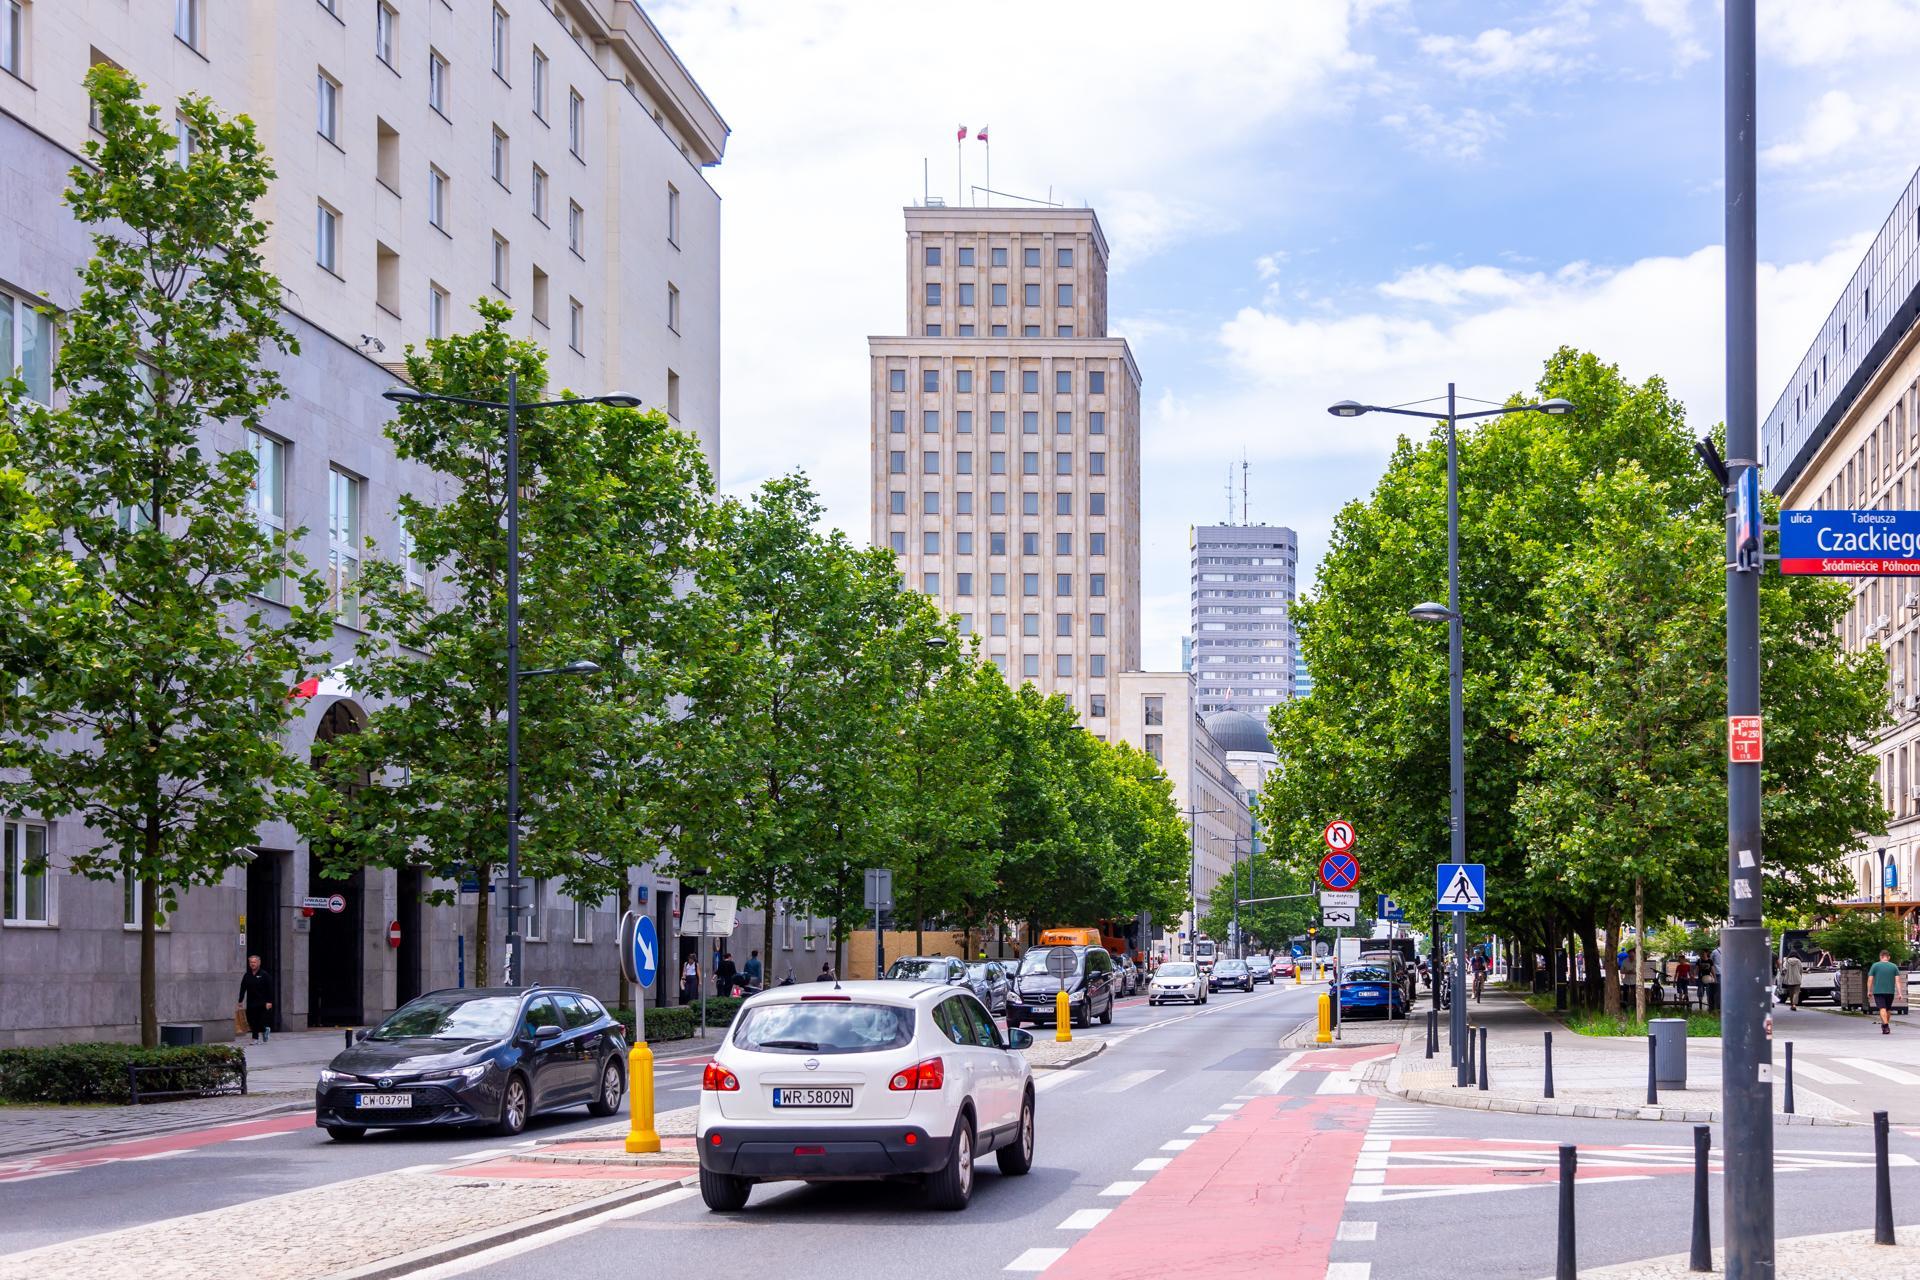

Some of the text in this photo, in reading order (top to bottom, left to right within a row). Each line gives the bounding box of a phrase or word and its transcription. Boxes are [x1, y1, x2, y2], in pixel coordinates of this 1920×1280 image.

[1790, 512, 1896, 524] ulica Tadeusza
[1821, 558, 1879, 572] Śródmieście
[1731, 722, 1741, 736] H
[362, 1095, 410, 1106] CW 0379H
[782, 1090, 850, 1104] WR 5809N
